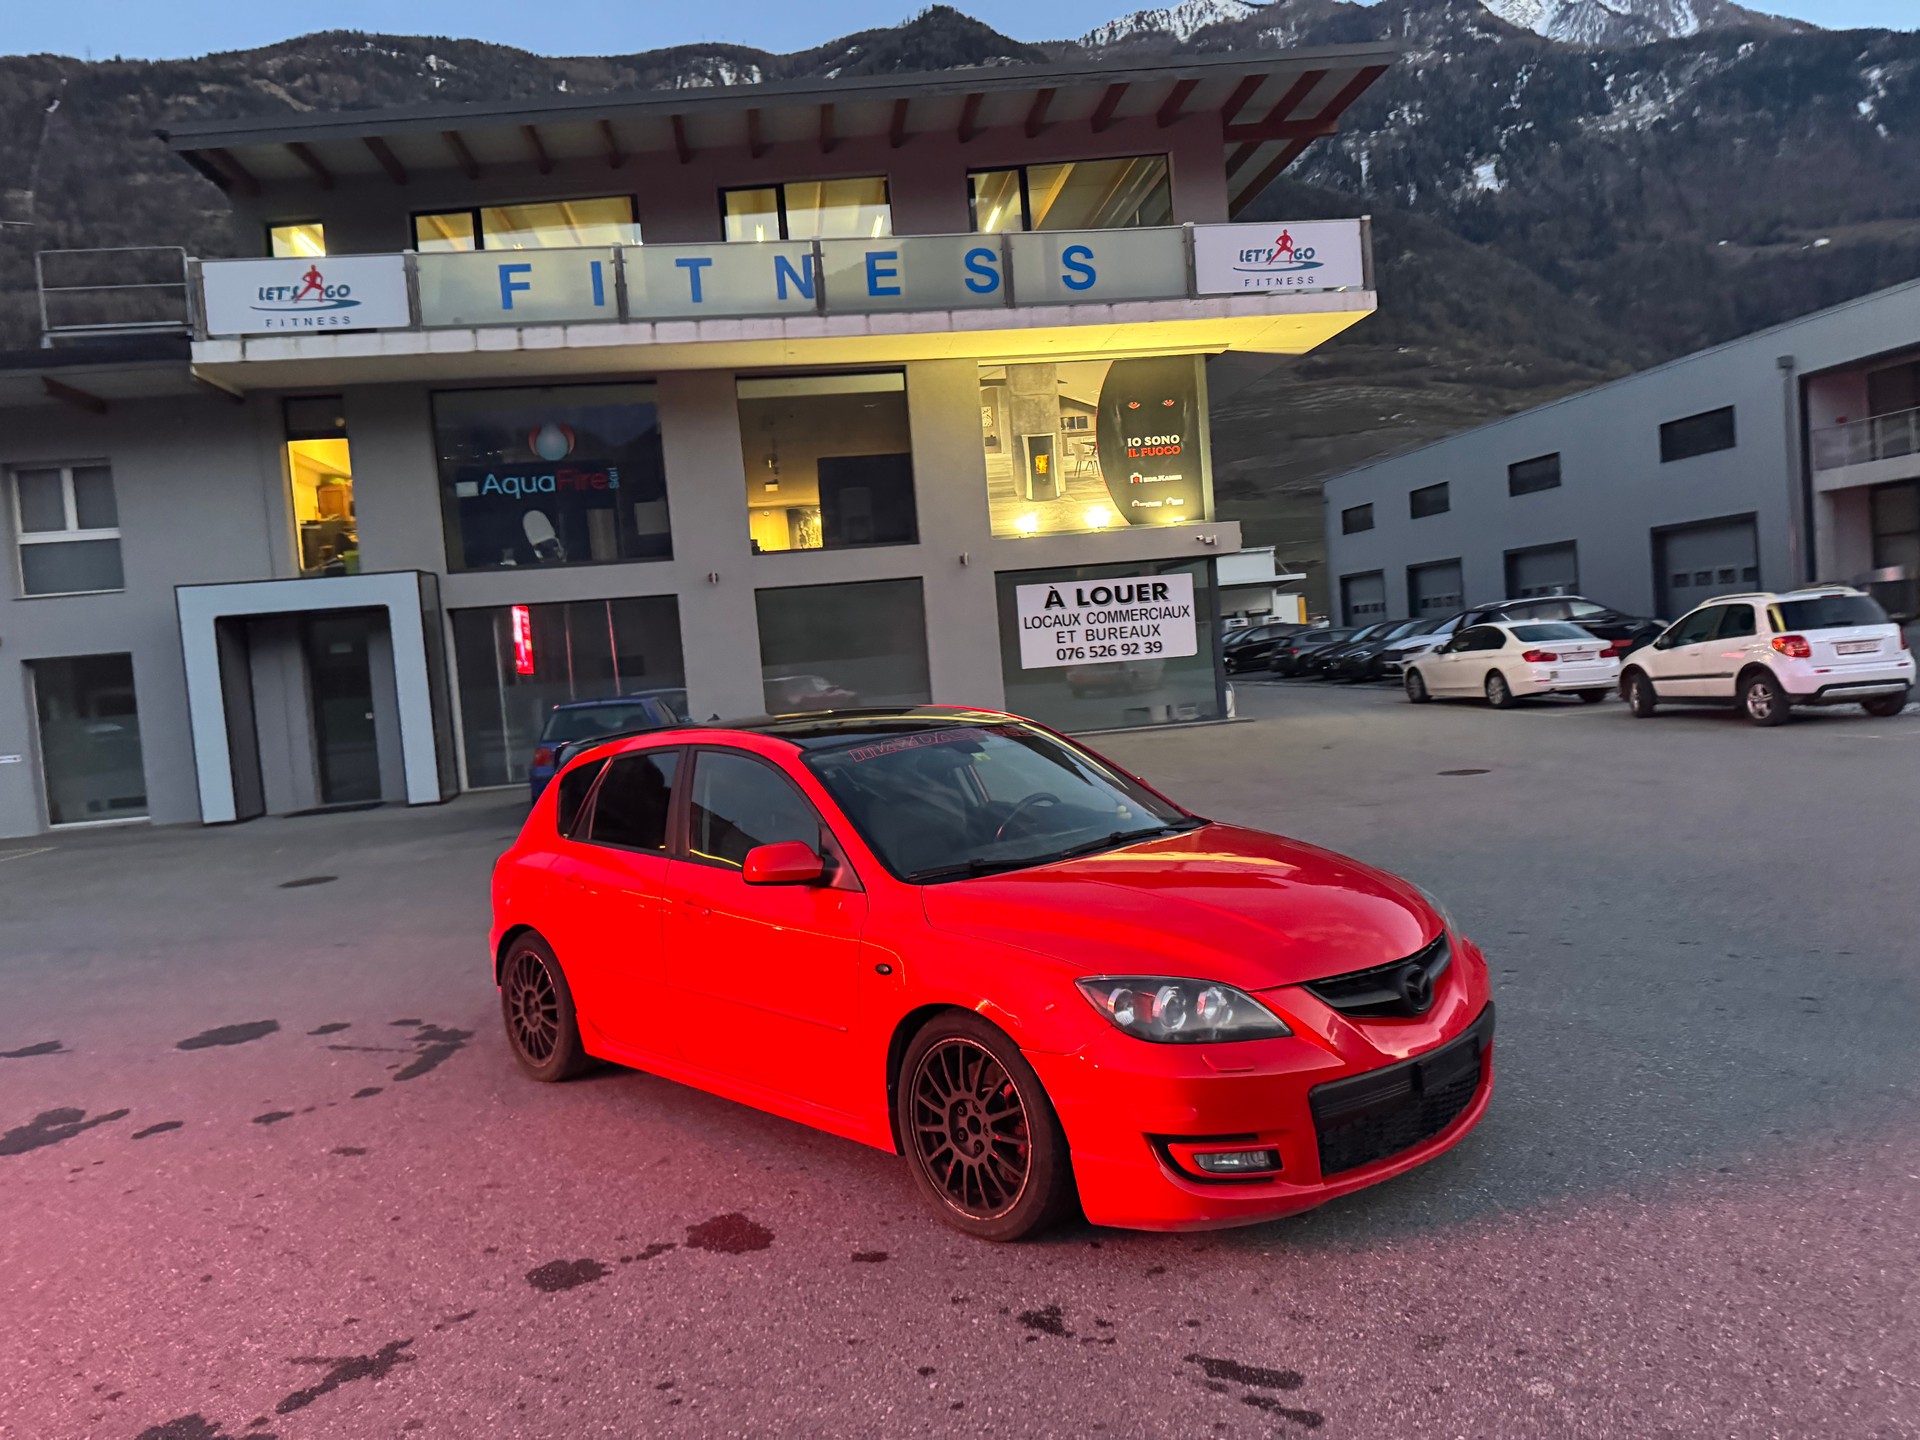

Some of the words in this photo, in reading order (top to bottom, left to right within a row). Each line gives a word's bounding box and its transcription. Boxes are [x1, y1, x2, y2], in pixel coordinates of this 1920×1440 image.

[1239, 248, 1274, 262] LET'S
[1293, 247, 1315, 260] GO
[499, 243, 1097, 311] FITNESS
[1244, 276, 1314, 287] FITNESS
[258, 285, 300, 301] LET'S
[324, 284, 351, 298] GO
[265, 316, 351, 328] FITNESS
[1127, 437, 1142, 447] IO
[1144, 434, 1180, 446] SONO
[1128, 448, 1140, 458] IL
[1141, 445, 1181, 457] FUOCO
[1044, 586, 1066, 609] À
[1076, 582, 1169, 607] LOUER
[1024, 613, 1082, 630] LOCAUX
[1086, 605, 1191, 625] COMMERCIAUX
[1056, 630, 1077, 644] ET
[1085, 623, 1161, 642] BUREAUX
[1056, 647, 1085, 660] 076
[1089, 644, 1117, 658] 526
[1121, 642, 1140, 656] 92
[1144, 641, 1163, 653] 39
